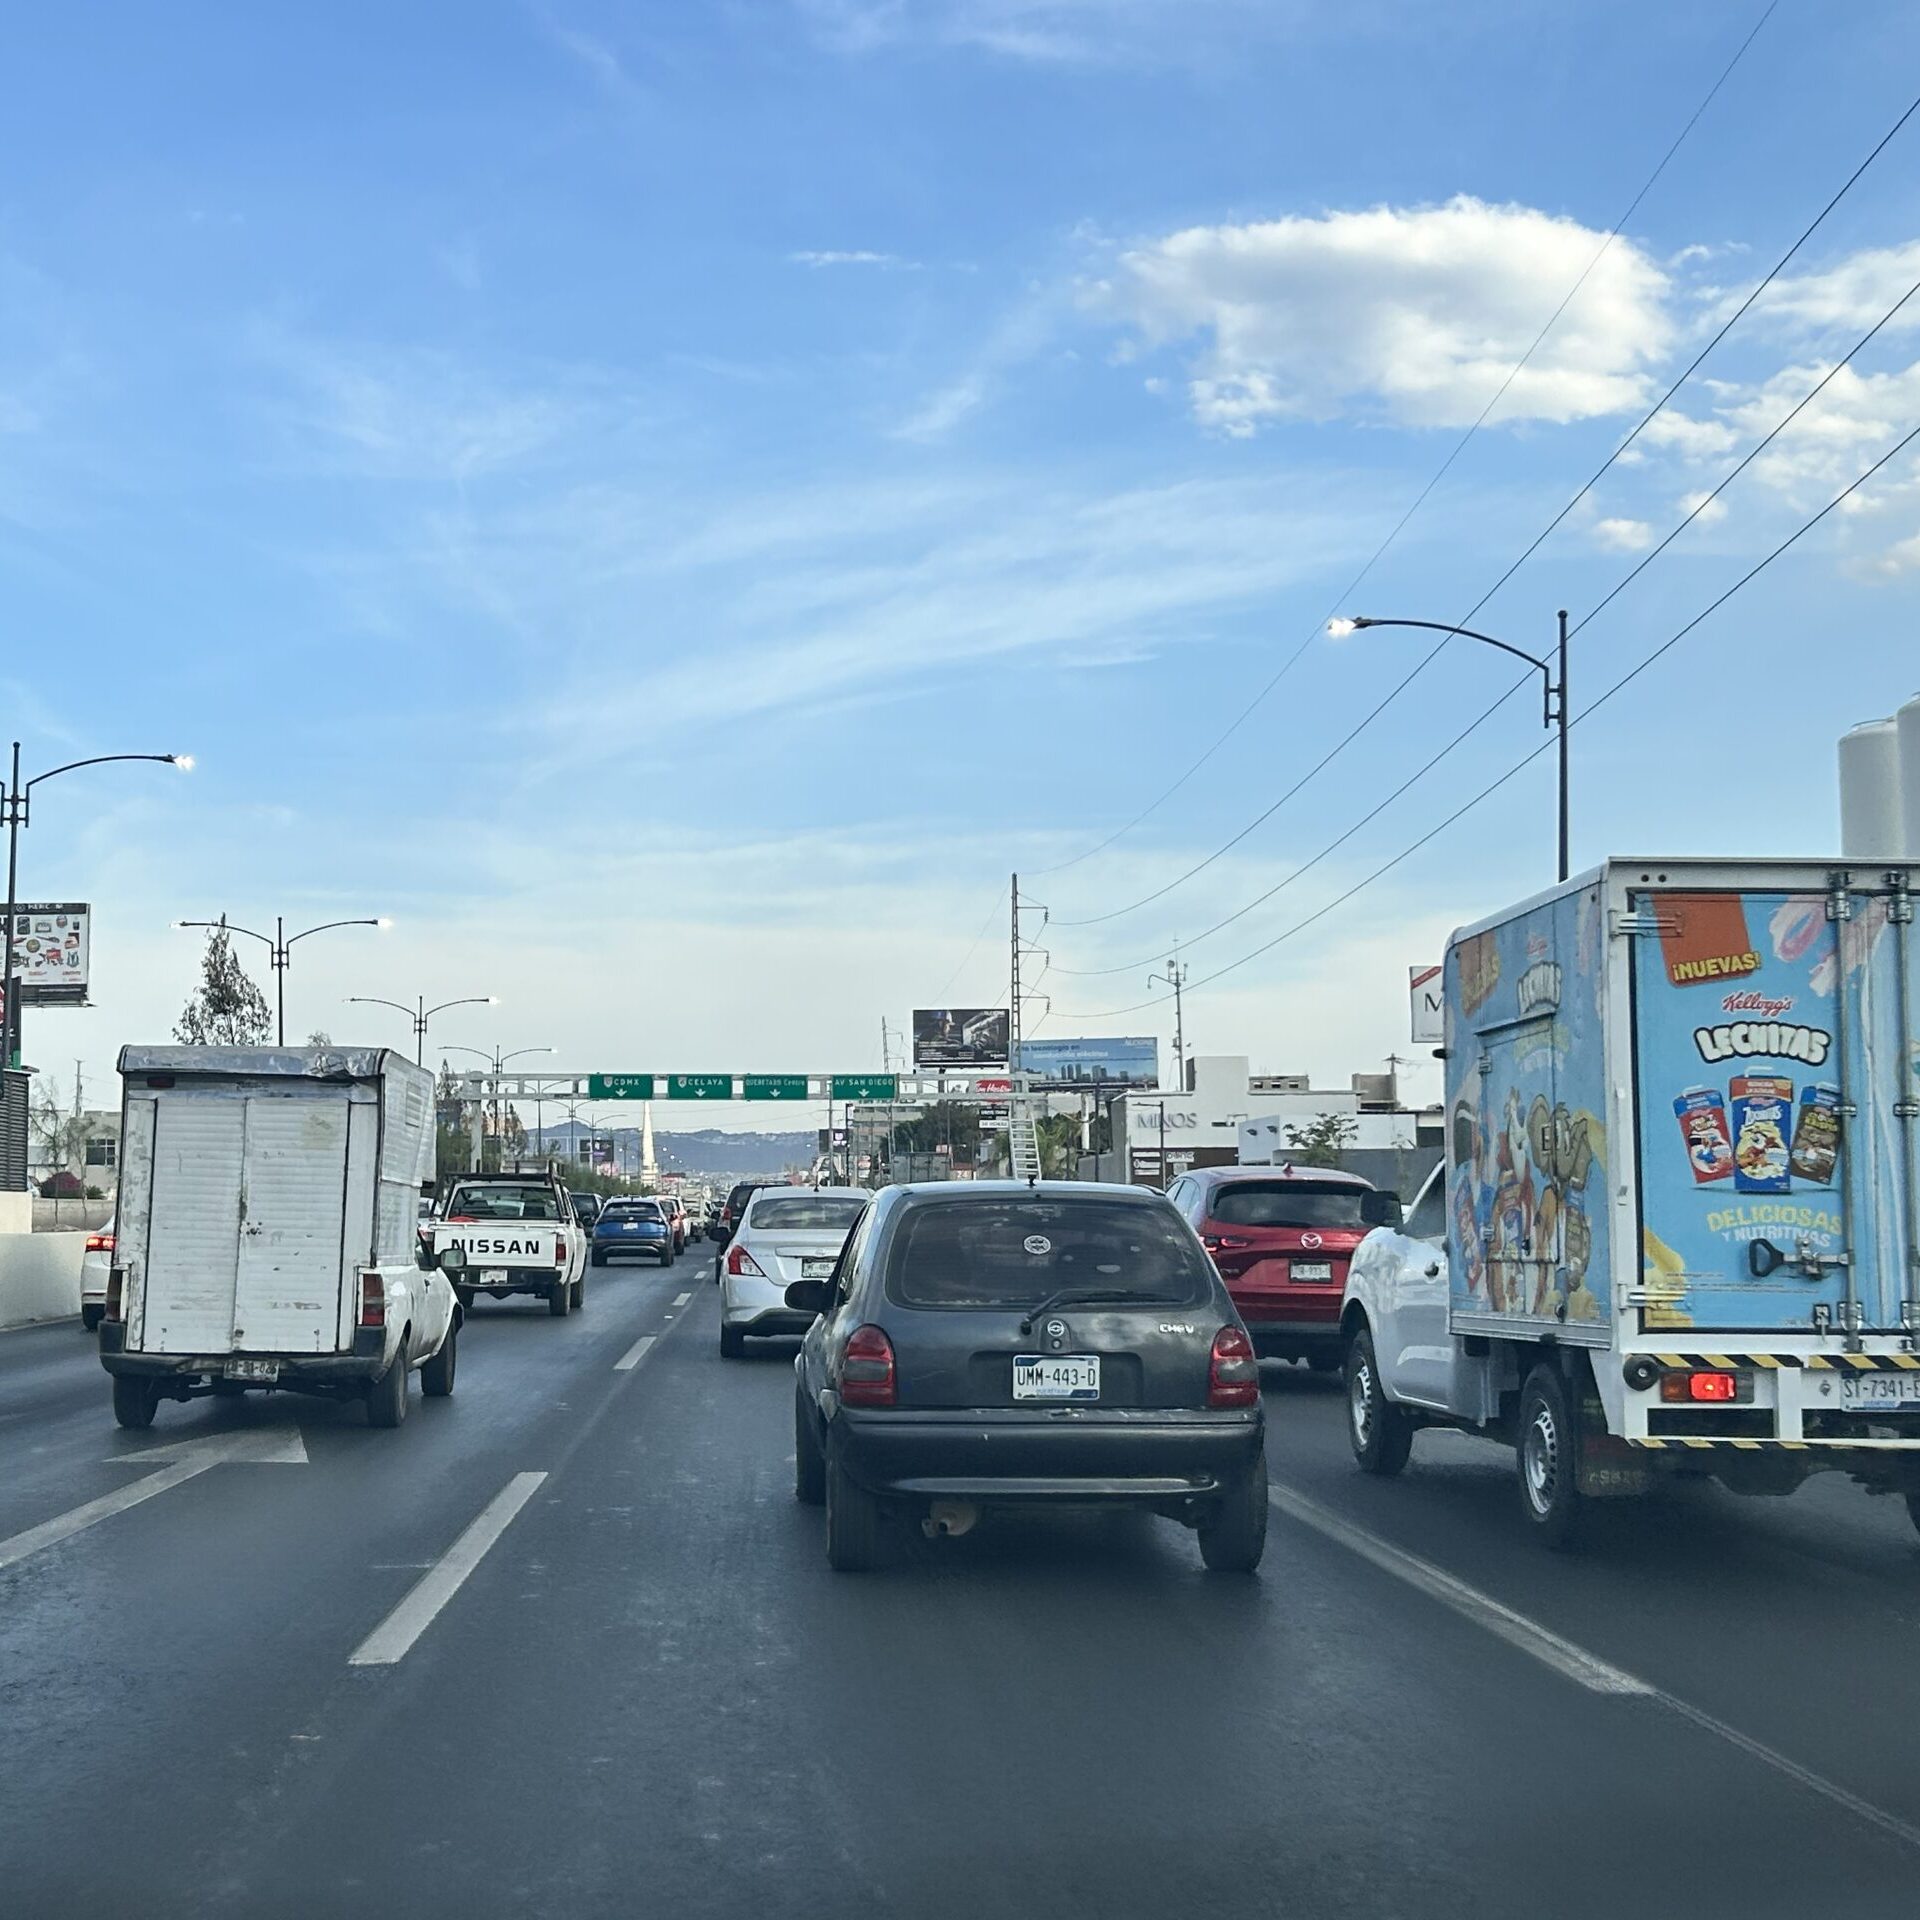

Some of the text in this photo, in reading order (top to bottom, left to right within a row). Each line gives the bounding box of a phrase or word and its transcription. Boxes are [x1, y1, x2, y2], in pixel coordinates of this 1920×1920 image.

[1673, 951, 1761, 981] ¡NUEVAS!
[1722, 992, 1794, 1017] Kellogg's
[1694, 1021, 1832, 1067] LECHITAS
[614, 1078, 639, 1086] CDMX
[688, 1078, 723, 1086] CELAYA
[834, 1078, 893, 1086] AV SAN DIEGO
[1707, 1204, 1841, 1235] DELICIOSAS
[1721, 1224, 1831, 1247] Y NUTRITIVAS
[451, 1239, 540, 1255] NISSAN
[1017, 1367, 1096, 1386] UMM-443-D
